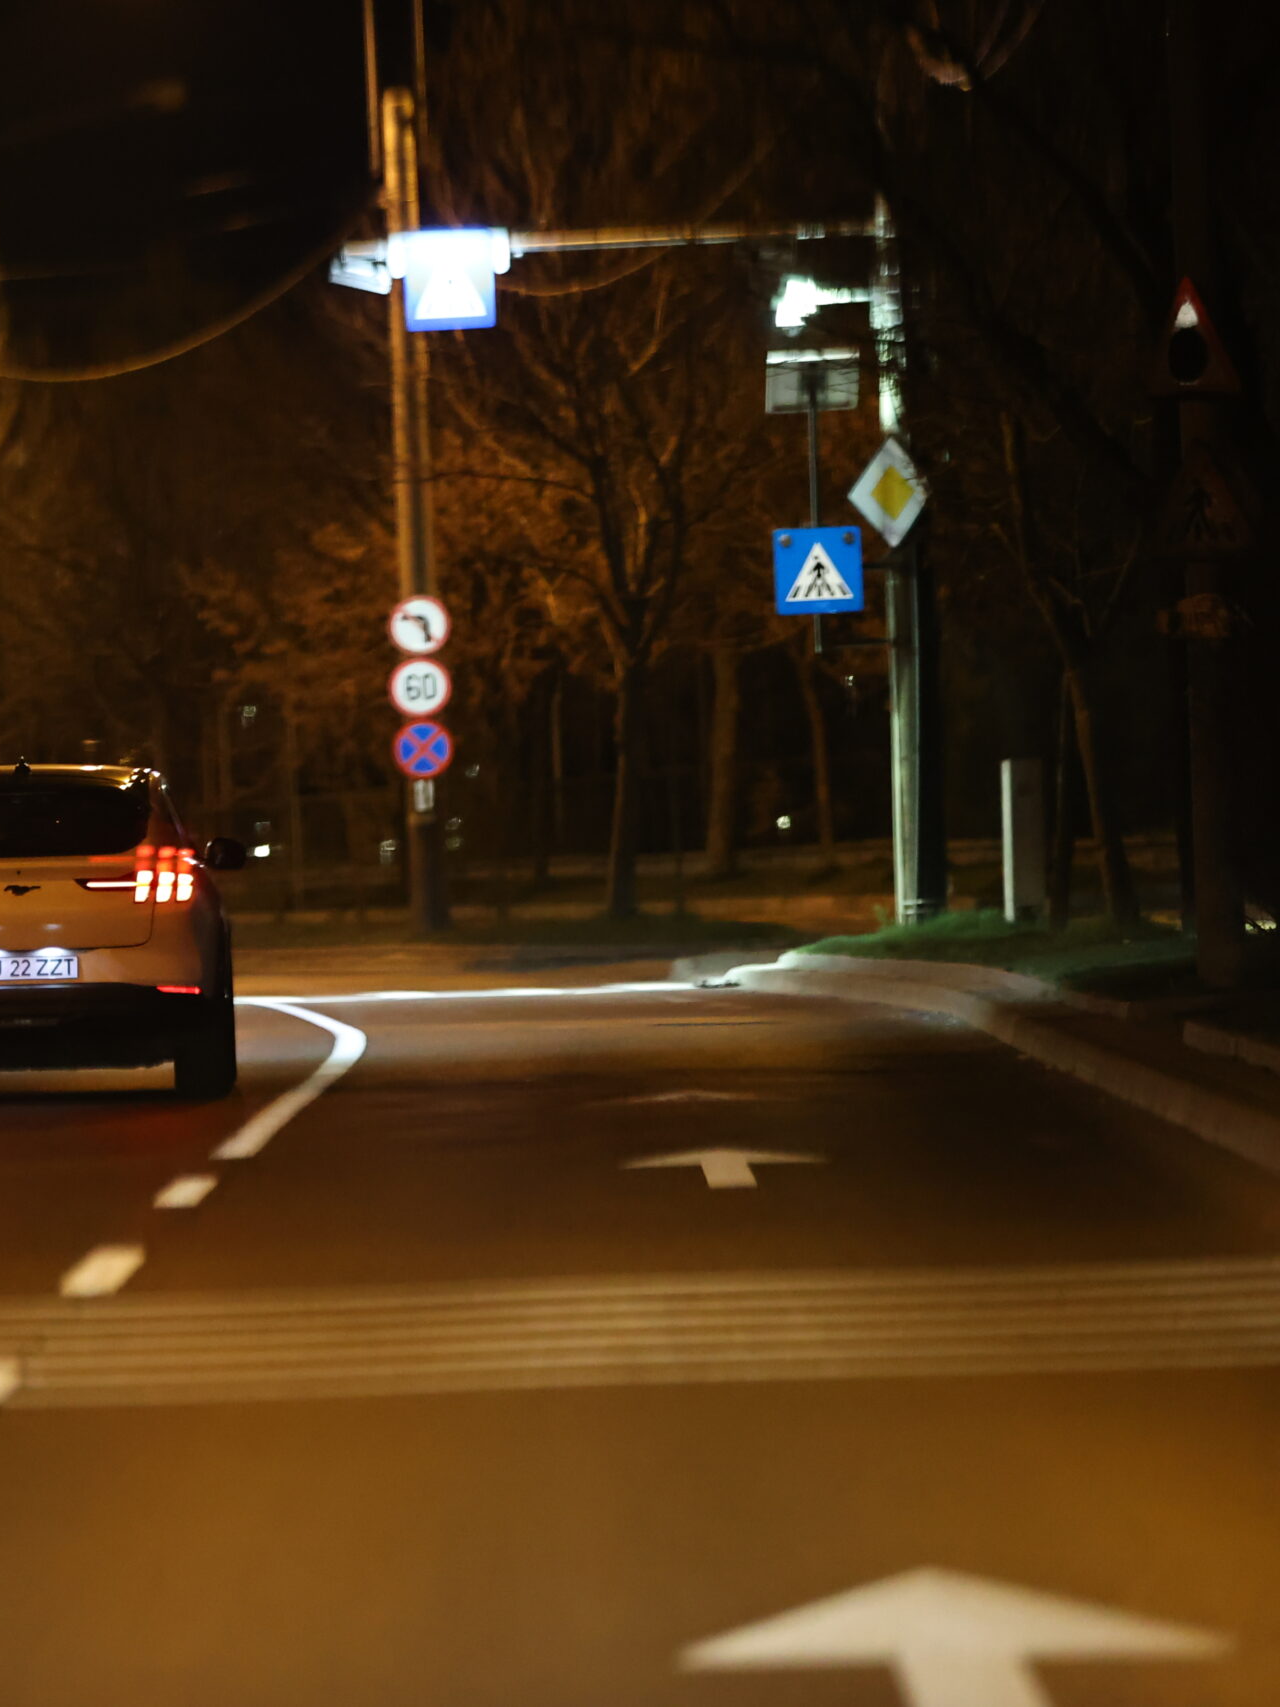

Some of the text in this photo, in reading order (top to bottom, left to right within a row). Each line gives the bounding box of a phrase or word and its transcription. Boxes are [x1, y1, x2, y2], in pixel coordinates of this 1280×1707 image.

[406, 673, 437, 700] 60
[10, 960, 31, 977] 22
[36, 958, 74, 976] ZZT
